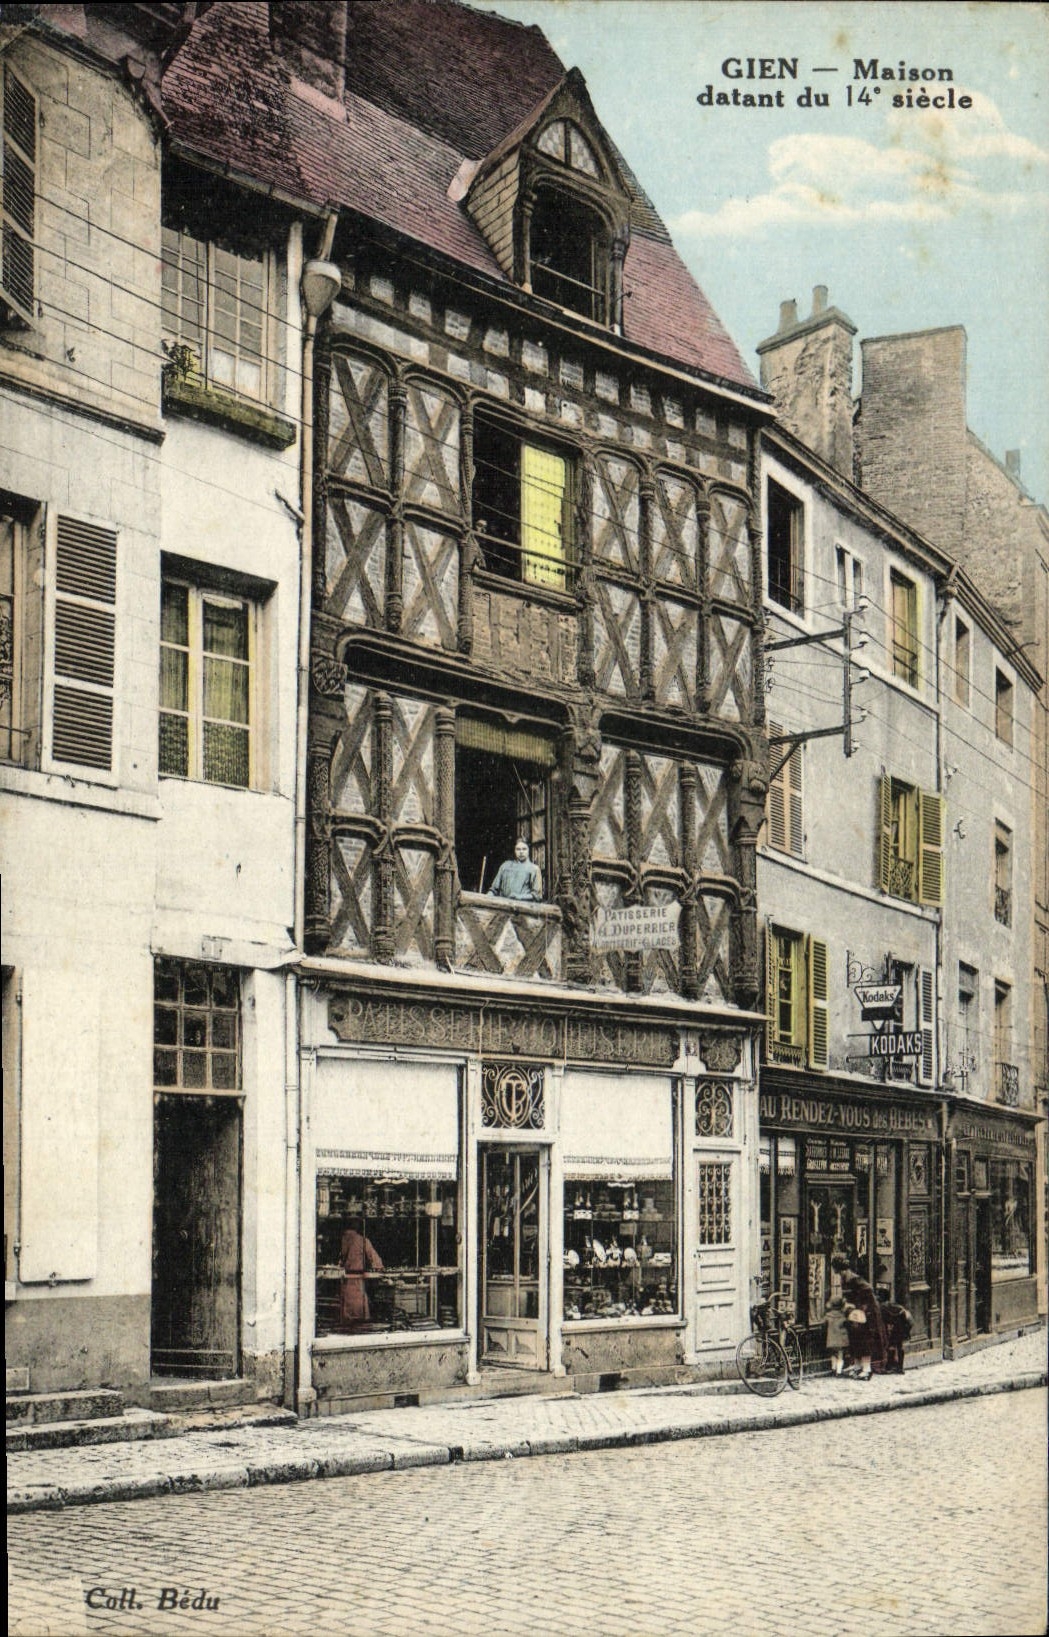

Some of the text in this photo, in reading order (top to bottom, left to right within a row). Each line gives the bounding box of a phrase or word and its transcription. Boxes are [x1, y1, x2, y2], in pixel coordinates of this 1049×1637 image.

[604, 907, 668, 921] PATISSERIE
[862, 989, 895, 1003] Kodaks
[871, 1033, 922, 1055] KODAKS
[760, 1095, 777, 1119] AU
[780, 1094, 871, 1129] RENDEZ-VOUS
[872, 1108, 888, 1129] des
